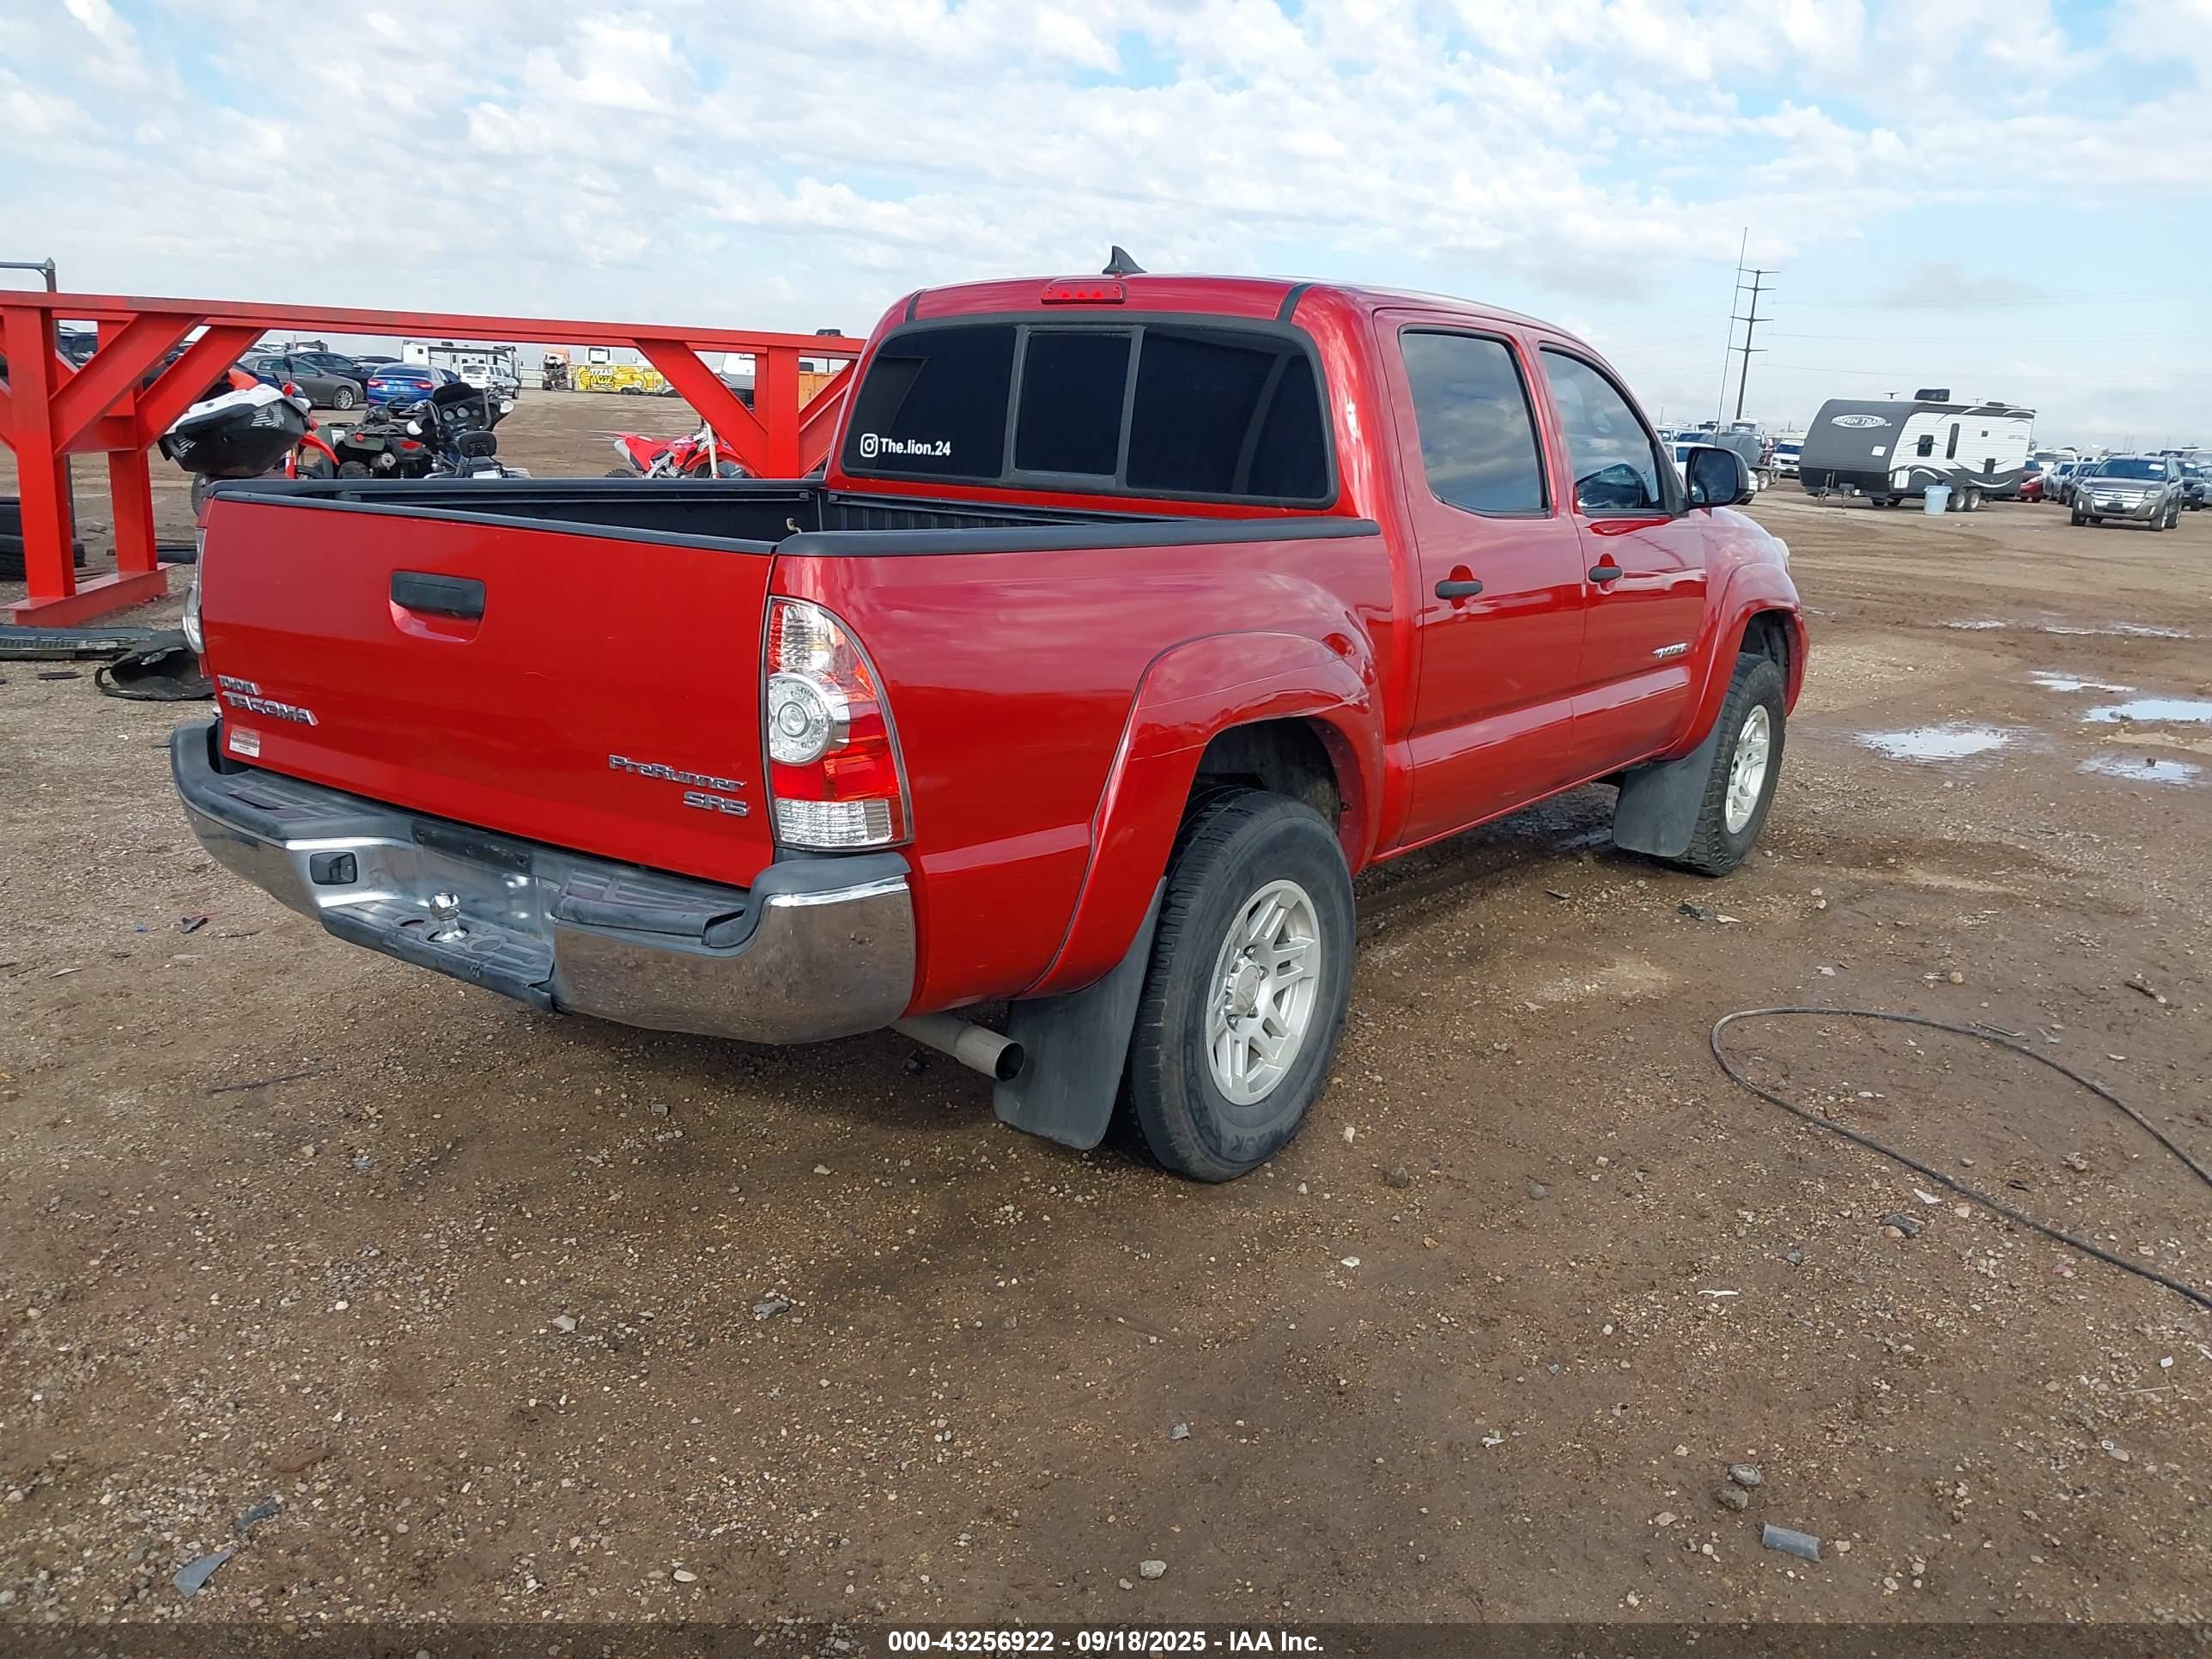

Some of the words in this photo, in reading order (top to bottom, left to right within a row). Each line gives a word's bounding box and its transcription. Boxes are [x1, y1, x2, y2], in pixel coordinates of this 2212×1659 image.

[880, 438, 951, 456] The.lion.24
[217, 674, 262, 696] TOYOTA
[222, 690, 319, 726] TACOMA
[608, 754, 748, 792] PreRunner
[683, 791, 750, 817] SR5
